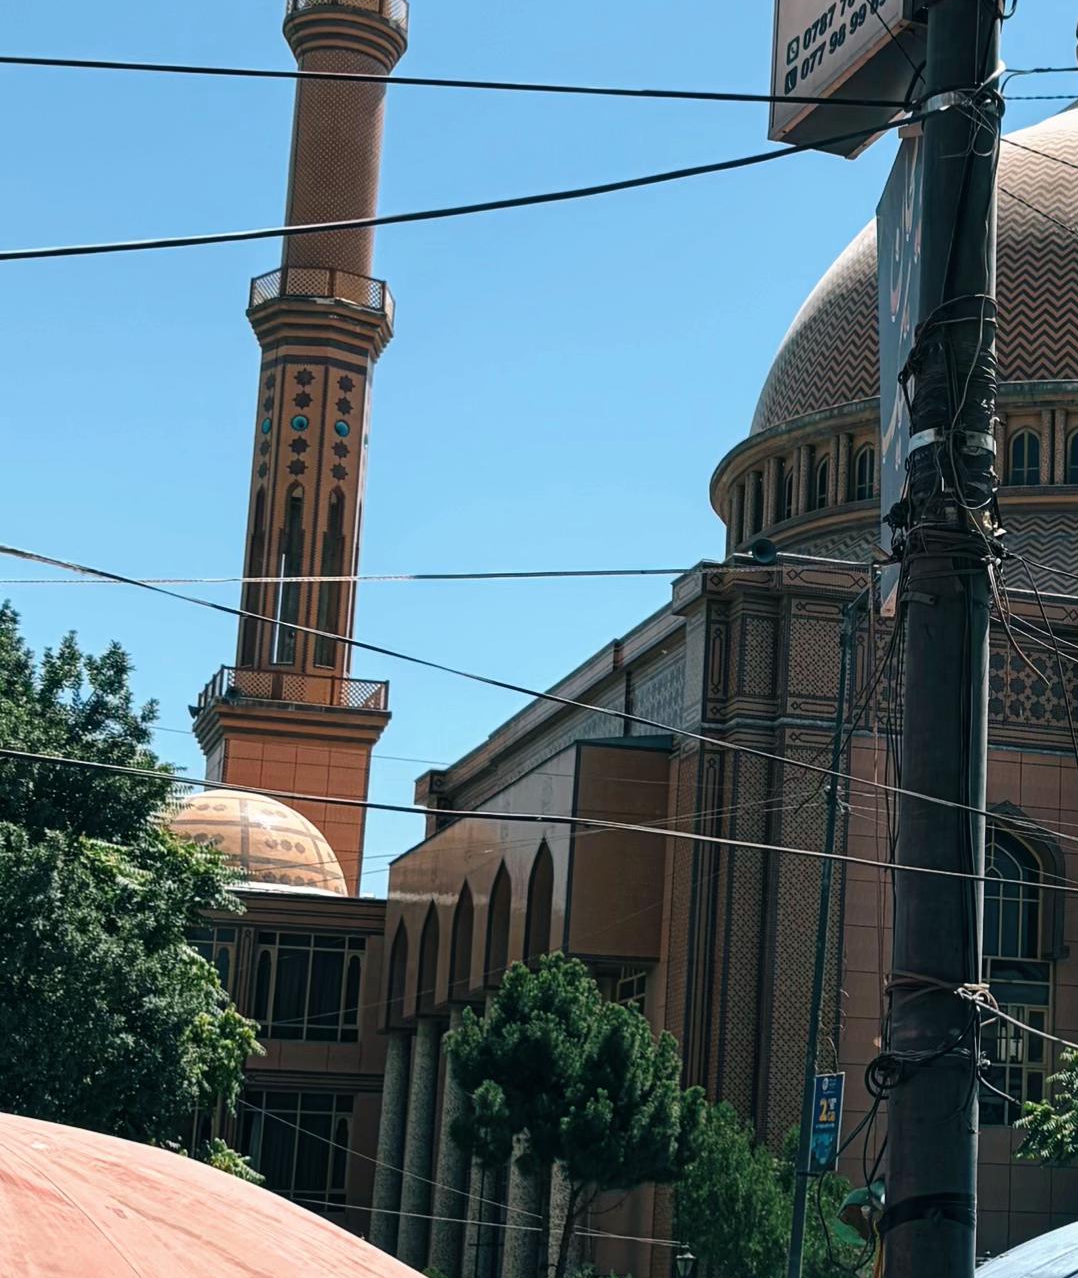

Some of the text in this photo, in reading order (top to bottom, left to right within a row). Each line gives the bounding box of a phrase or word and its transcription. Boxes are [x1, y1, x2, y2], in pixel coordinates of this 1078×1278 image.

[800, 40, 827, 80] 077
[829, 23, 847, 55] 98
[849, 3, 867, 35] 99
[803, 2, 837, 50] 0787
